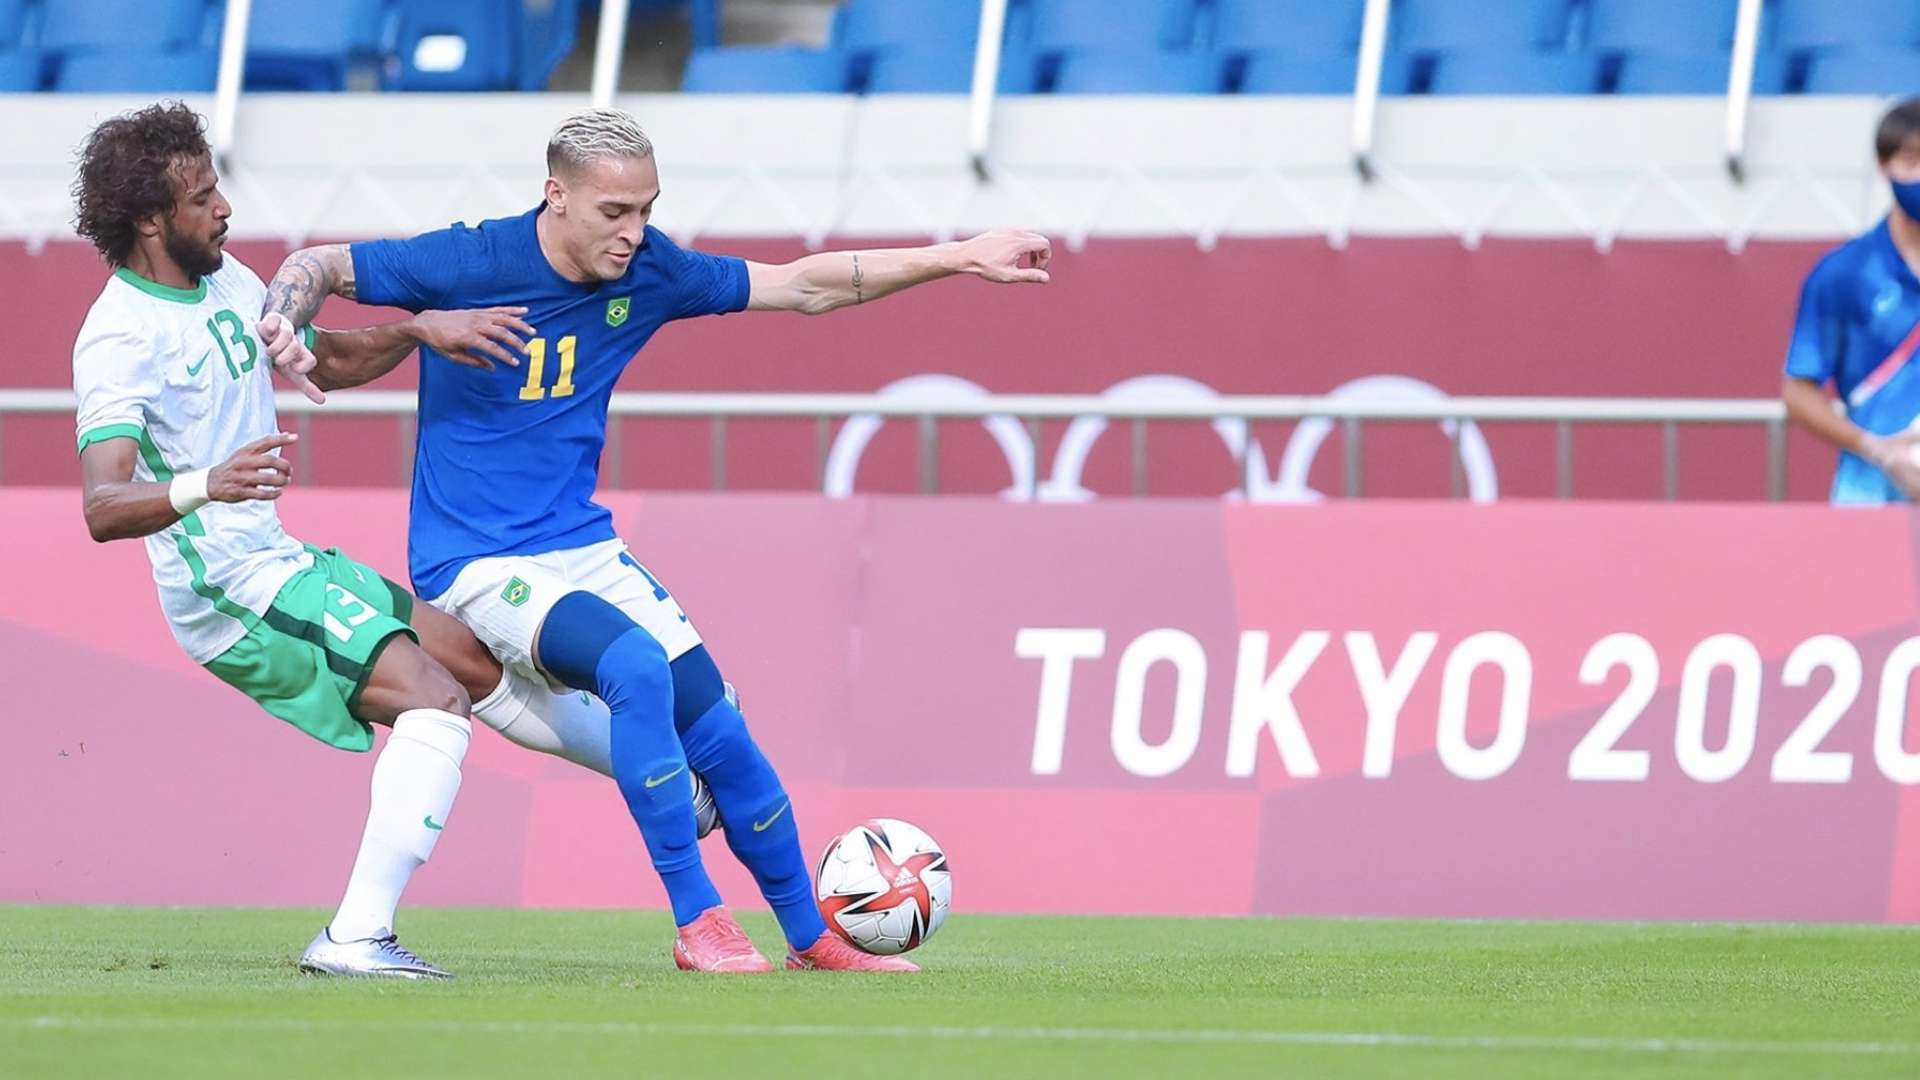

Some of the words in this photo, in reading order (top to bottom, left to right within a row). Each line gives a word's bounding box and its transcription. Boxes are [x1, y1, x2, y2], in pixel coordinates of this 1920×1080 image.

[206, 309, 257, 380] 13
[519, 335, 577, 400] 11
[322, 582, 379, 643] 13
[1014, 627, 1533, 779] TOKYO
[1567, 632, 1920, 785] 2020
